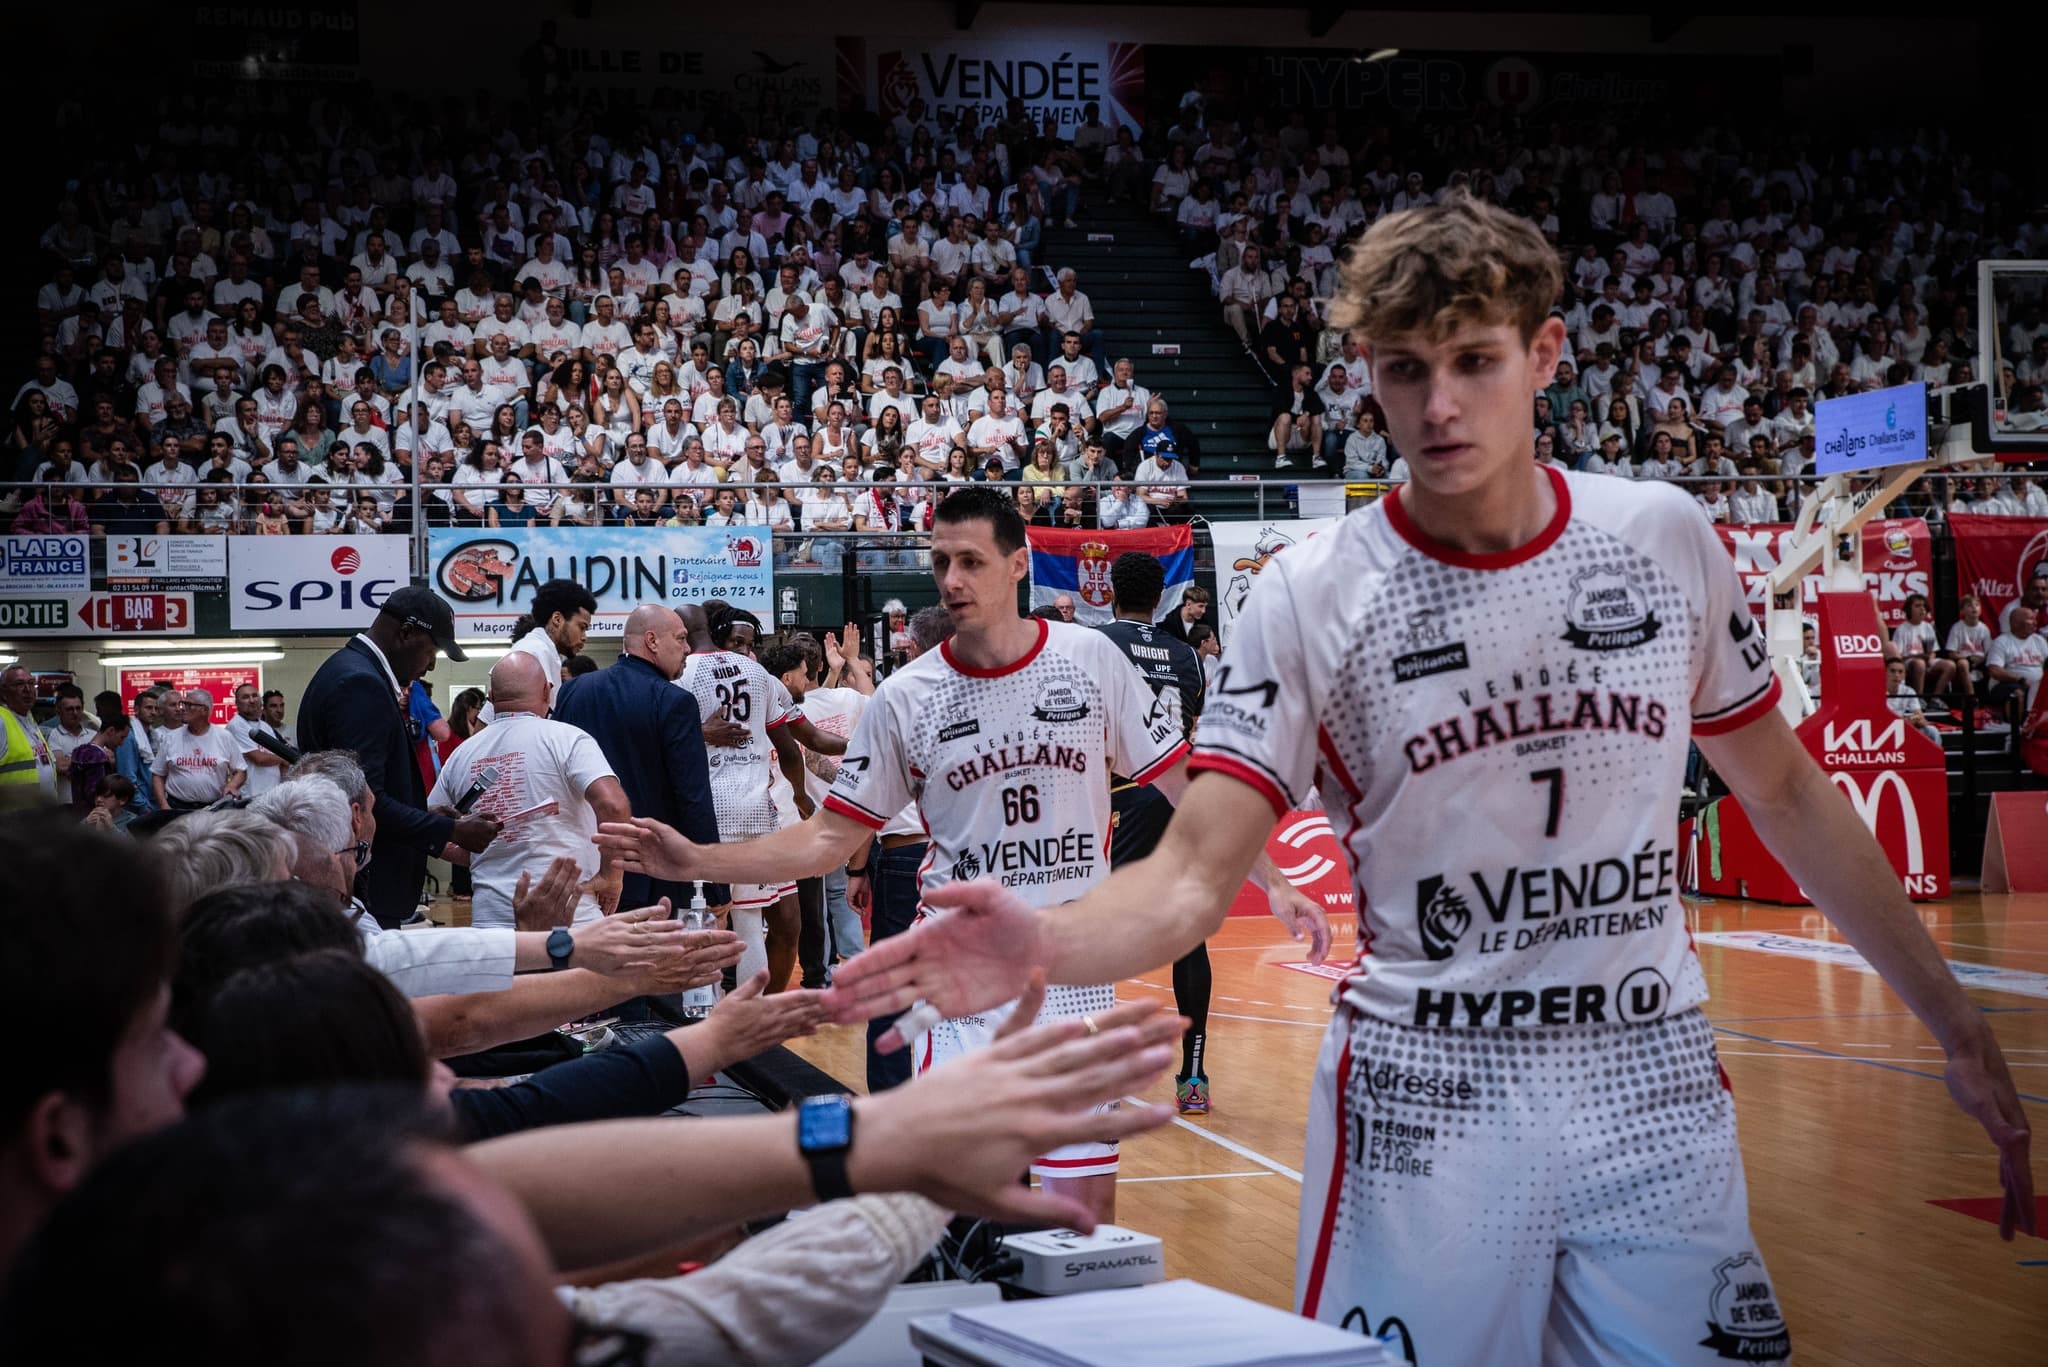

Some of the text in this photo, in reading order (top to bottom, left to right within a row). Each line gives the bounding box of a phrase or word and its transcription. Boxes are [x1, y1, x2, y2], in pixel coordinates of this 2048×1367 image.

[309, 9, 355, 31] Pub
[570, 49, 704, 74] ILLE DE
[921, 52, 1101, 101] VENDÉE
[1264, 56, 1467, 111] HYPER
[8, 539, 84, 558] LABO
[8, 559, 84, 574] FRANCE
[436, 538, 667, 607] GAUDIN
[673, 557, 727, 566] Partenaire
[689, 572, 758, 583] Rejoignez-nous
[244, 580, 396, 611] SPIE
[672, 586, 765, 597] 02 51 68 72 74
[1586, 587, 1628, 605] JAMBON
[0, 604, 64, 625] ORTIE
[124, 598, 153, 620] BAR
[1583, 602, 1636, 622] DE VENDÉE
[473, 622, 624, 635] Maçon erture
[1588, 629, 1645, 647] Petitgas
[1130, 643, 1170, 661] WRIGHT
[1841, 634, 1883, 653] BDO
[1155, 664, 1172, 673] UPF
[1047, 688, 1072, 697] JAMBON
[1458, 661, 1603, 707] VENDÉE
[716, 678, 751, 722] 35
[1044, 696, 1077, 706] DE VENDÉE
[1046, 711, 1081, 720] Petitgas
[974, 728, 1055, 754] VENDÉE
[1404, 690, 1667, 774] CHALLANS
[1824, 719, 1906, 752] KIA
[1515, 736, 1569, 758] BASKET
[176, 756, 218, 768] CHALLANS
[947, 743, 1087, 792] CHALLANS
[1824, 752, 1906, 765] CHALLANS
[838, 768, 860, 784] ORAL
[1002, 784, 1041, 827] 66
[1531, 767, 1564, 838] 7
[982, 828, 1094, 872] VENDÉE
[1001, 864, 1094, 888] DÉPARTEMENT
[1471, 840, 1674, 923] VENDÉE
[1480, 930, 1511, 954] LE
[1414, 983, 1607, 1028] HYPER
[1371, 1117, 1436, 1141] RÉGION
[1371, 1136, 1413, 1157] PAYS
[1384, 1154, 1433, 1177] LOIRE
[1064, 1255, 1158, 1278] STRAMATEL
[1735, 1282, 1769, 1302] JAMBO
[1730, 1306, 1746, 1324] DE
